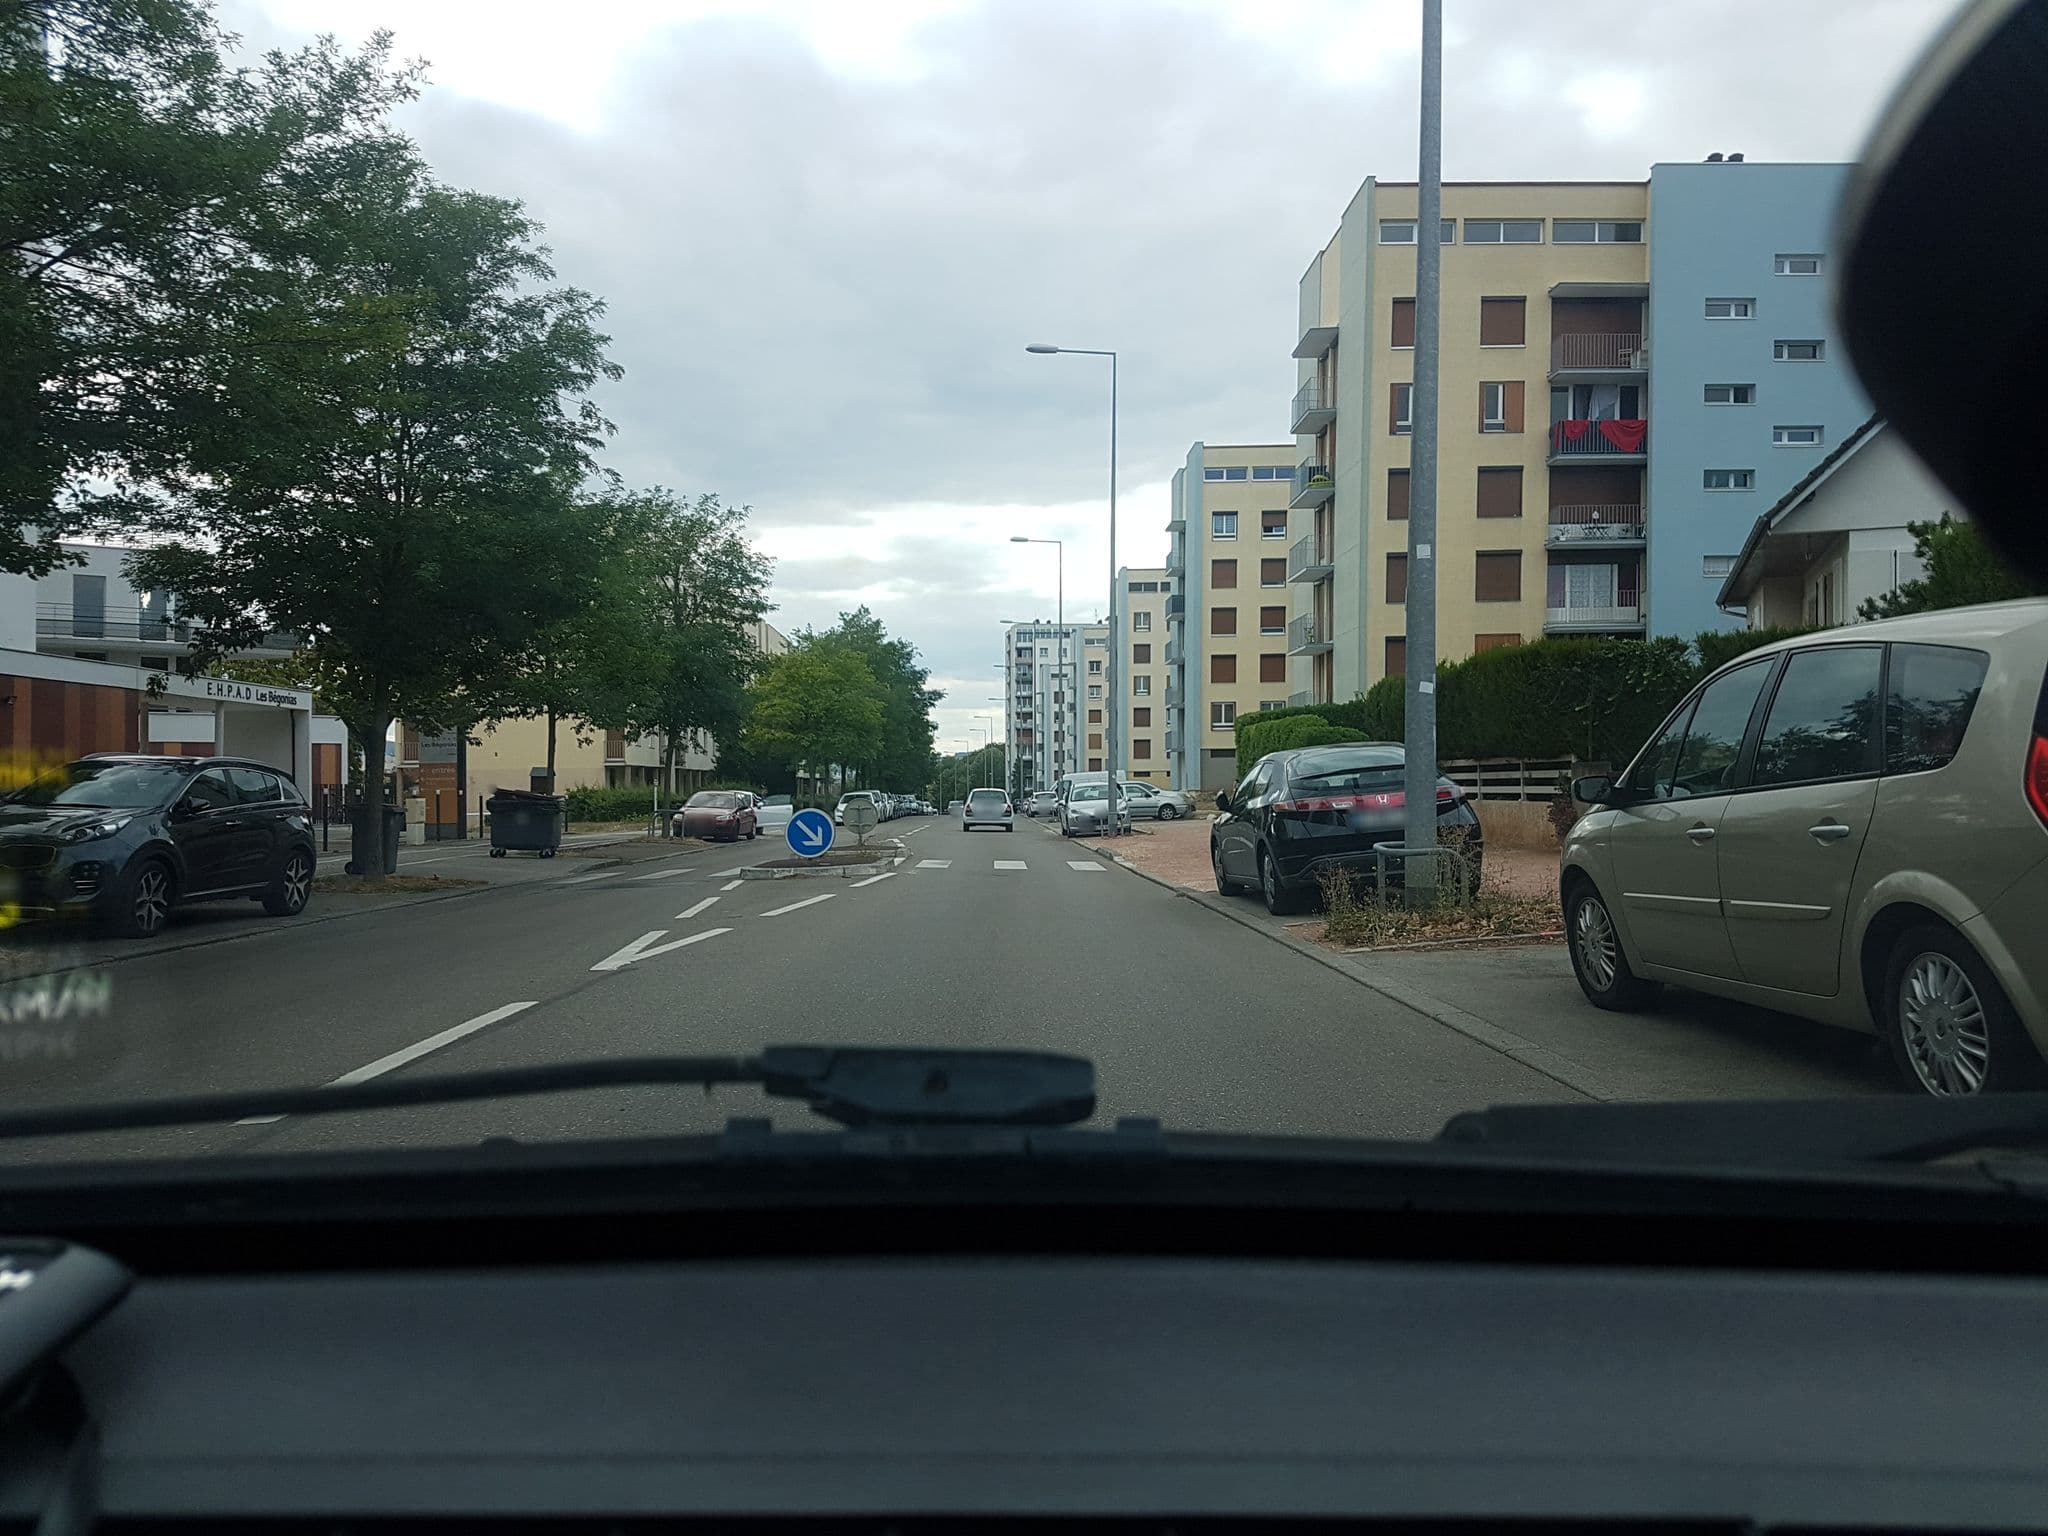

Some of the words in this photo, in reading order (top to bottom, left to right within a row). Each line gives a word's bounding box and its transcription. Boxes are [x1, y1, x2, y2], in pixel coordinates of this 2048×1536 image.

[207, 682, 251, 700] E.H.P.A.D
[256, 689, 267, 702] Les
[268, 690, 298, 706] Bégonias
